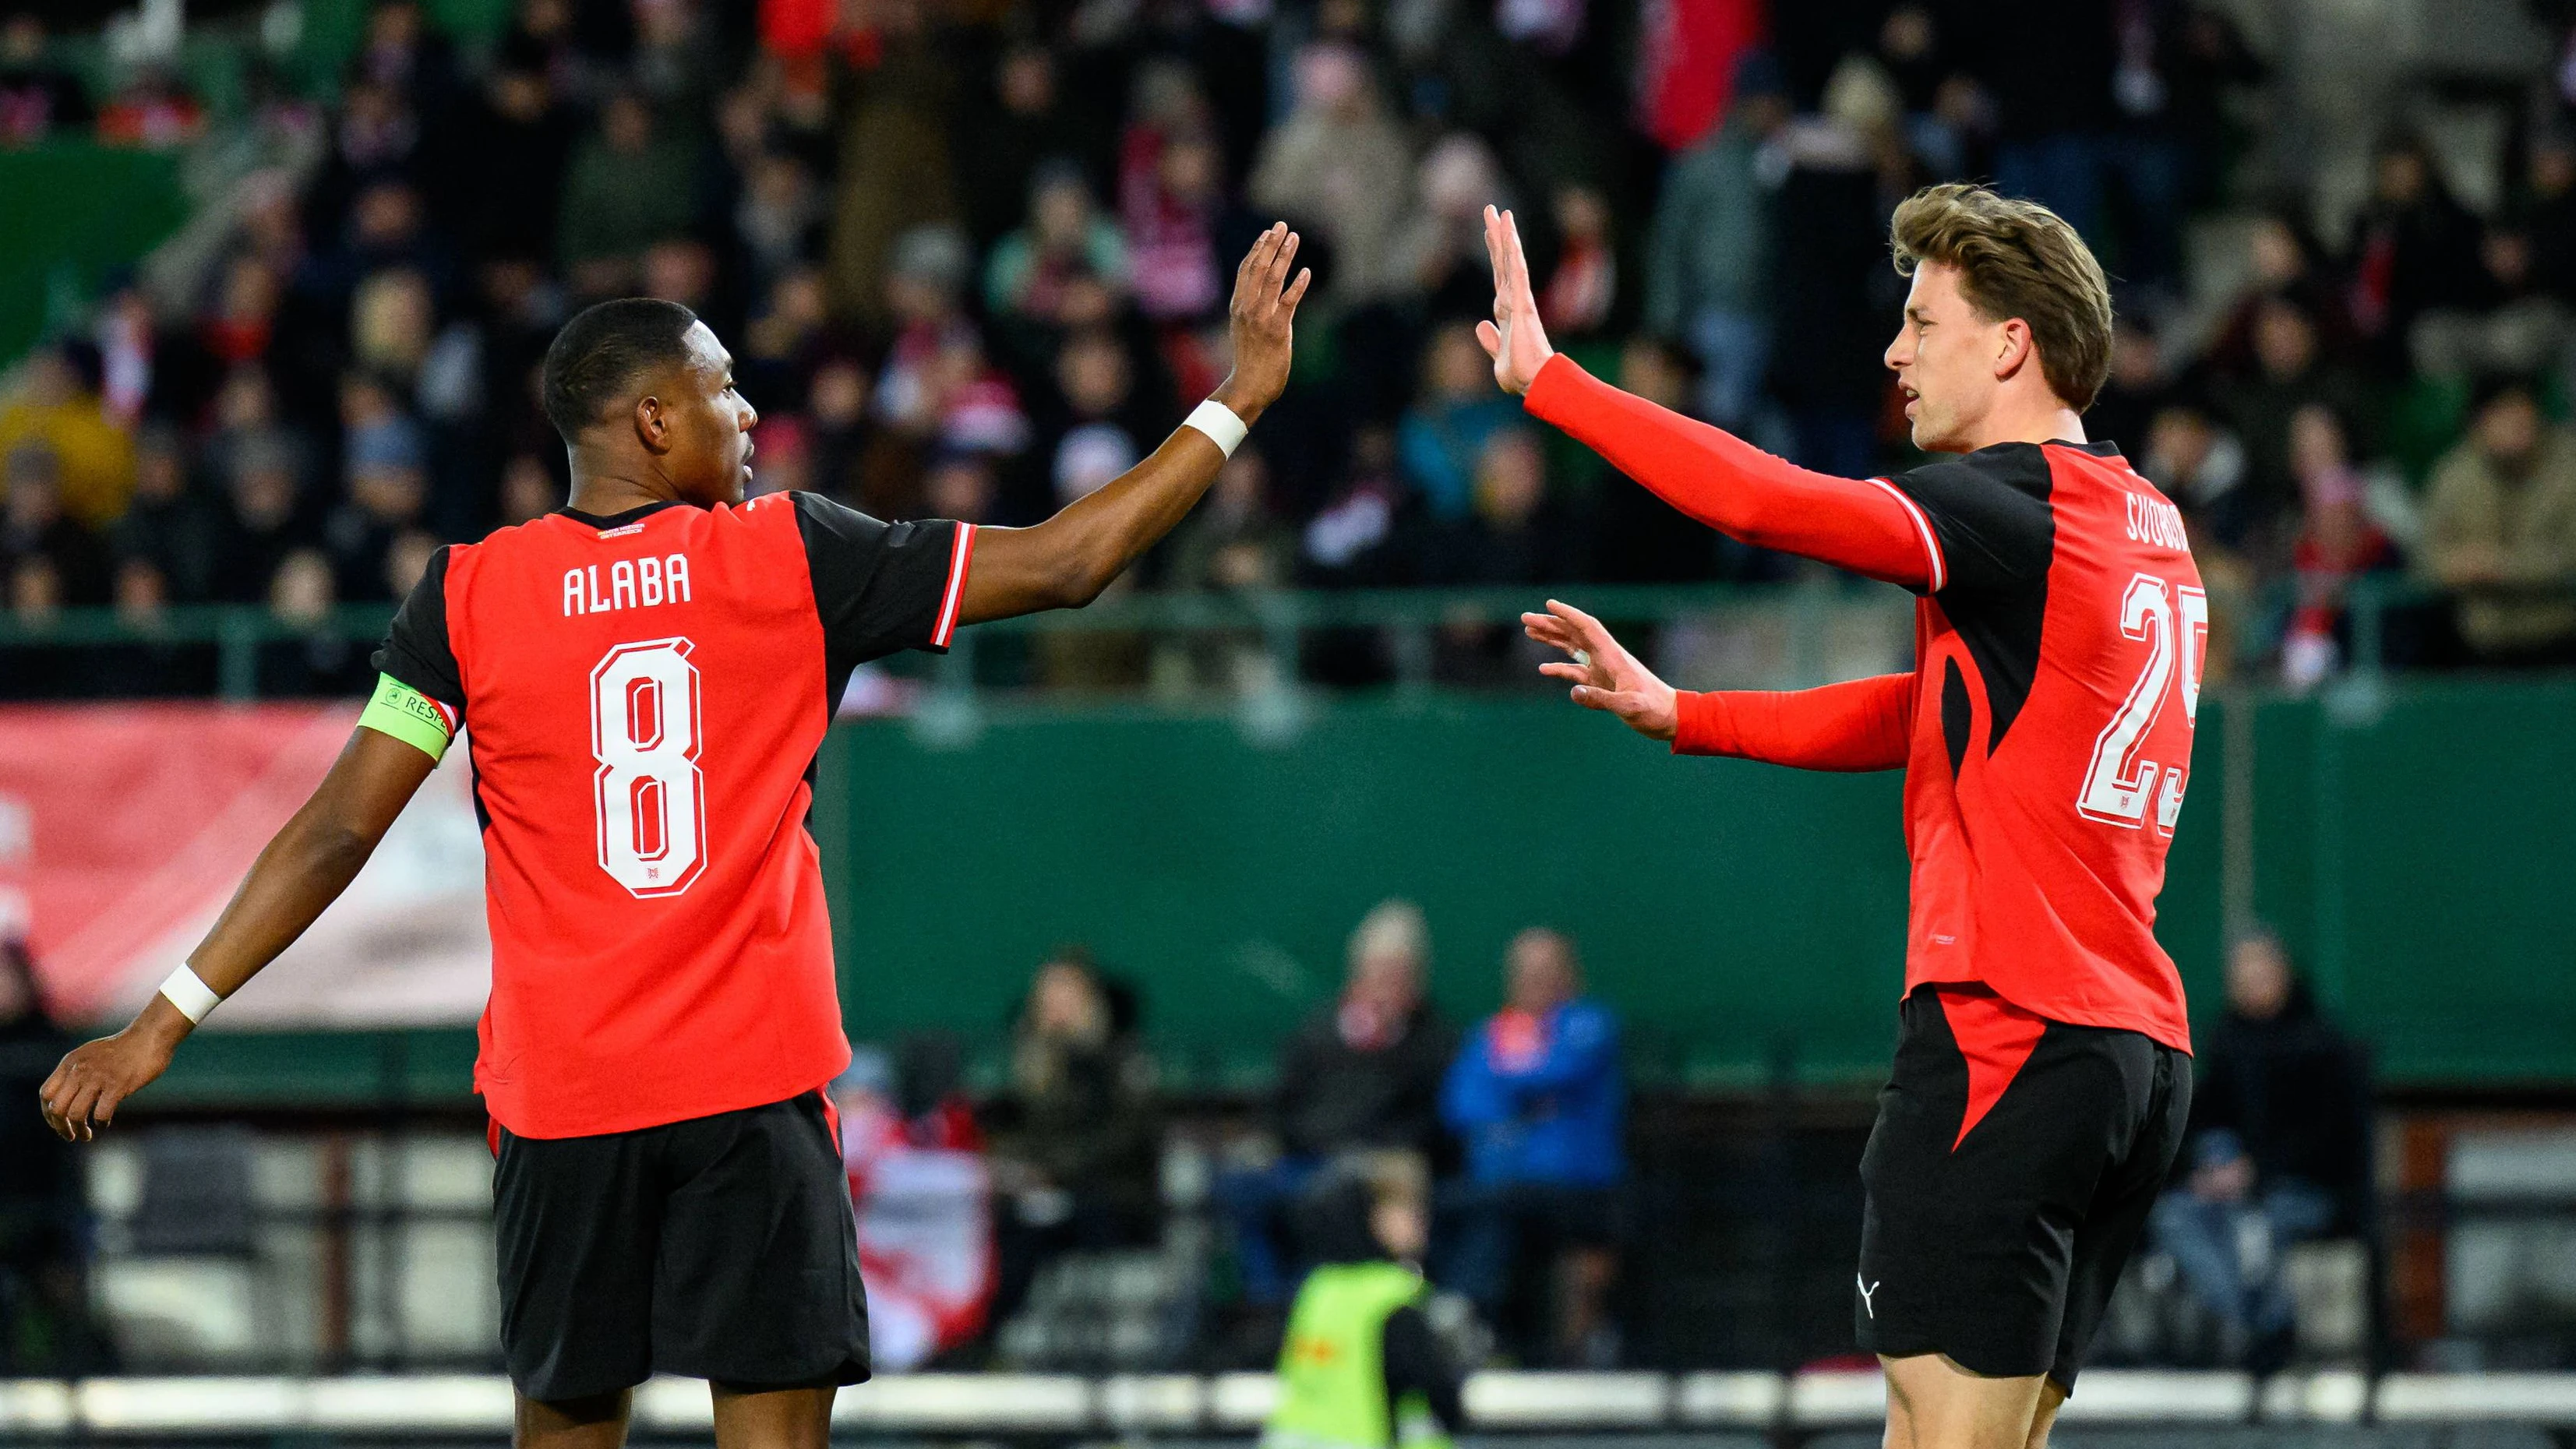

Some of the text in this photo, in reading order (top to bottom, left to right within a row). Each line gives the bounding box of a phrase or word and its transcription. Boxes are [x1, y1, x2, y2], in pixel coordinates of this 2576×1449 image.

[563, 553, 691, 617] ALABA
[2076, 572, 2208, 839] 25
[589, 636, 708, 899] 8
